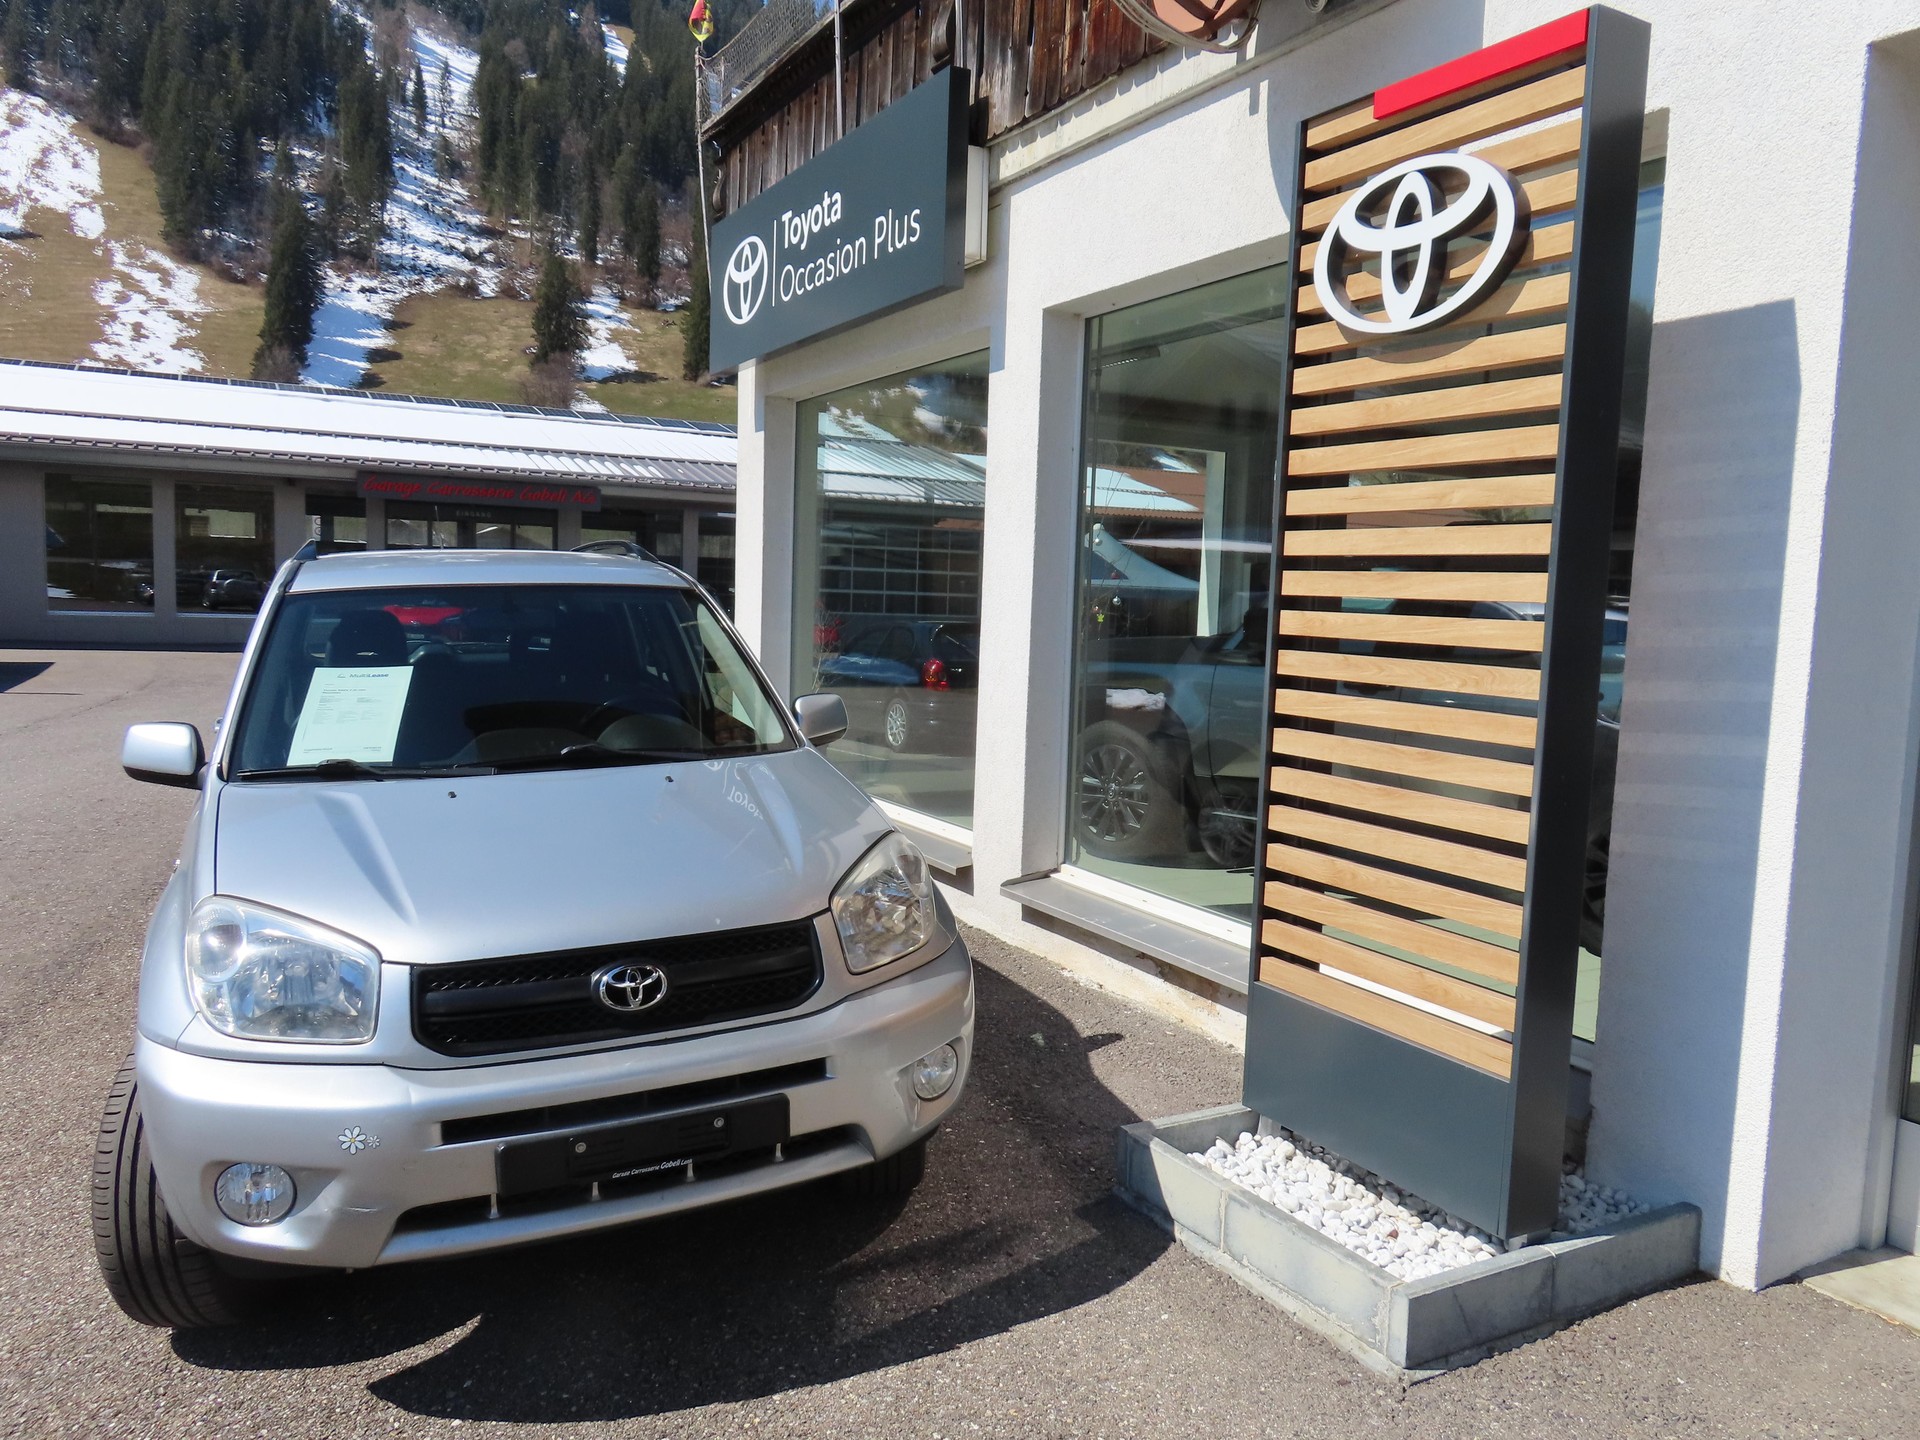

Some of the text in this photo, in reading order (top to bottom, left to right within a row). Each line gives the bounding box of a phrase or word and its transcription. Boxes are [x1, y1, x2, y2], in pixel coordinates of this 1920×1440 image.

[781, 190, 842, 251] Toyota
[780, 208, 921, 302] Occasion Plus
[363, 475, 422, 500] Garage
[427, 481, 516, 499] Carrosserie
[519, 485, 568, 503] Gobeli
[660, 1158, 682, 1170] Gobeli
